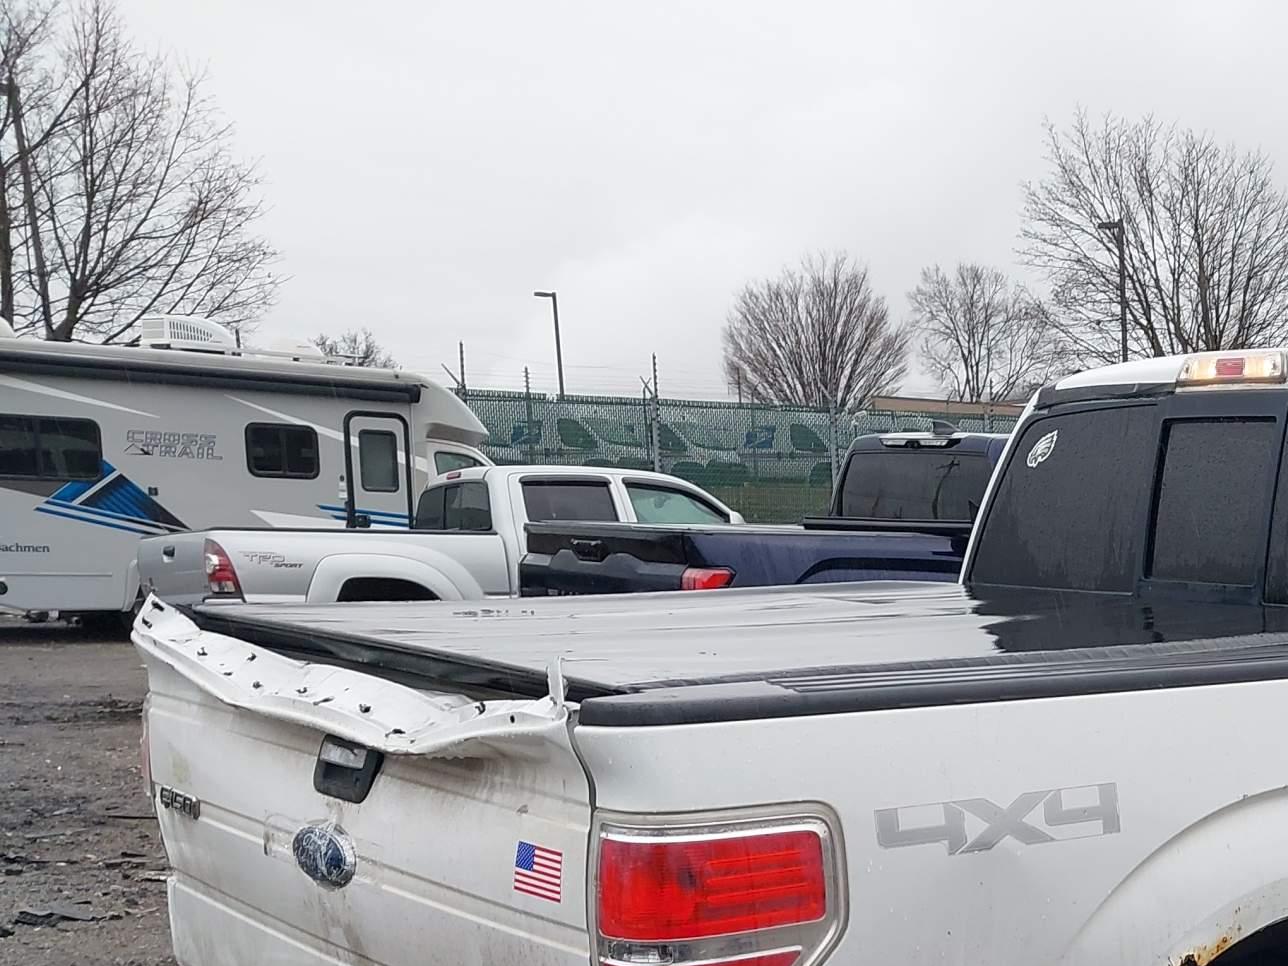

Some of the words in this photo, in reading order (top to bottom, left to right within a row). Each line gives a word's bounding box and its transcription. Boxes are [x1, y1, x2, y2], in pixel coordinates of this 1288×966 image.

[126, 429, 217, 447] CROSS
[142, 443, 223, 460] TRAIL
[0, 542, 50, 553] achmen
